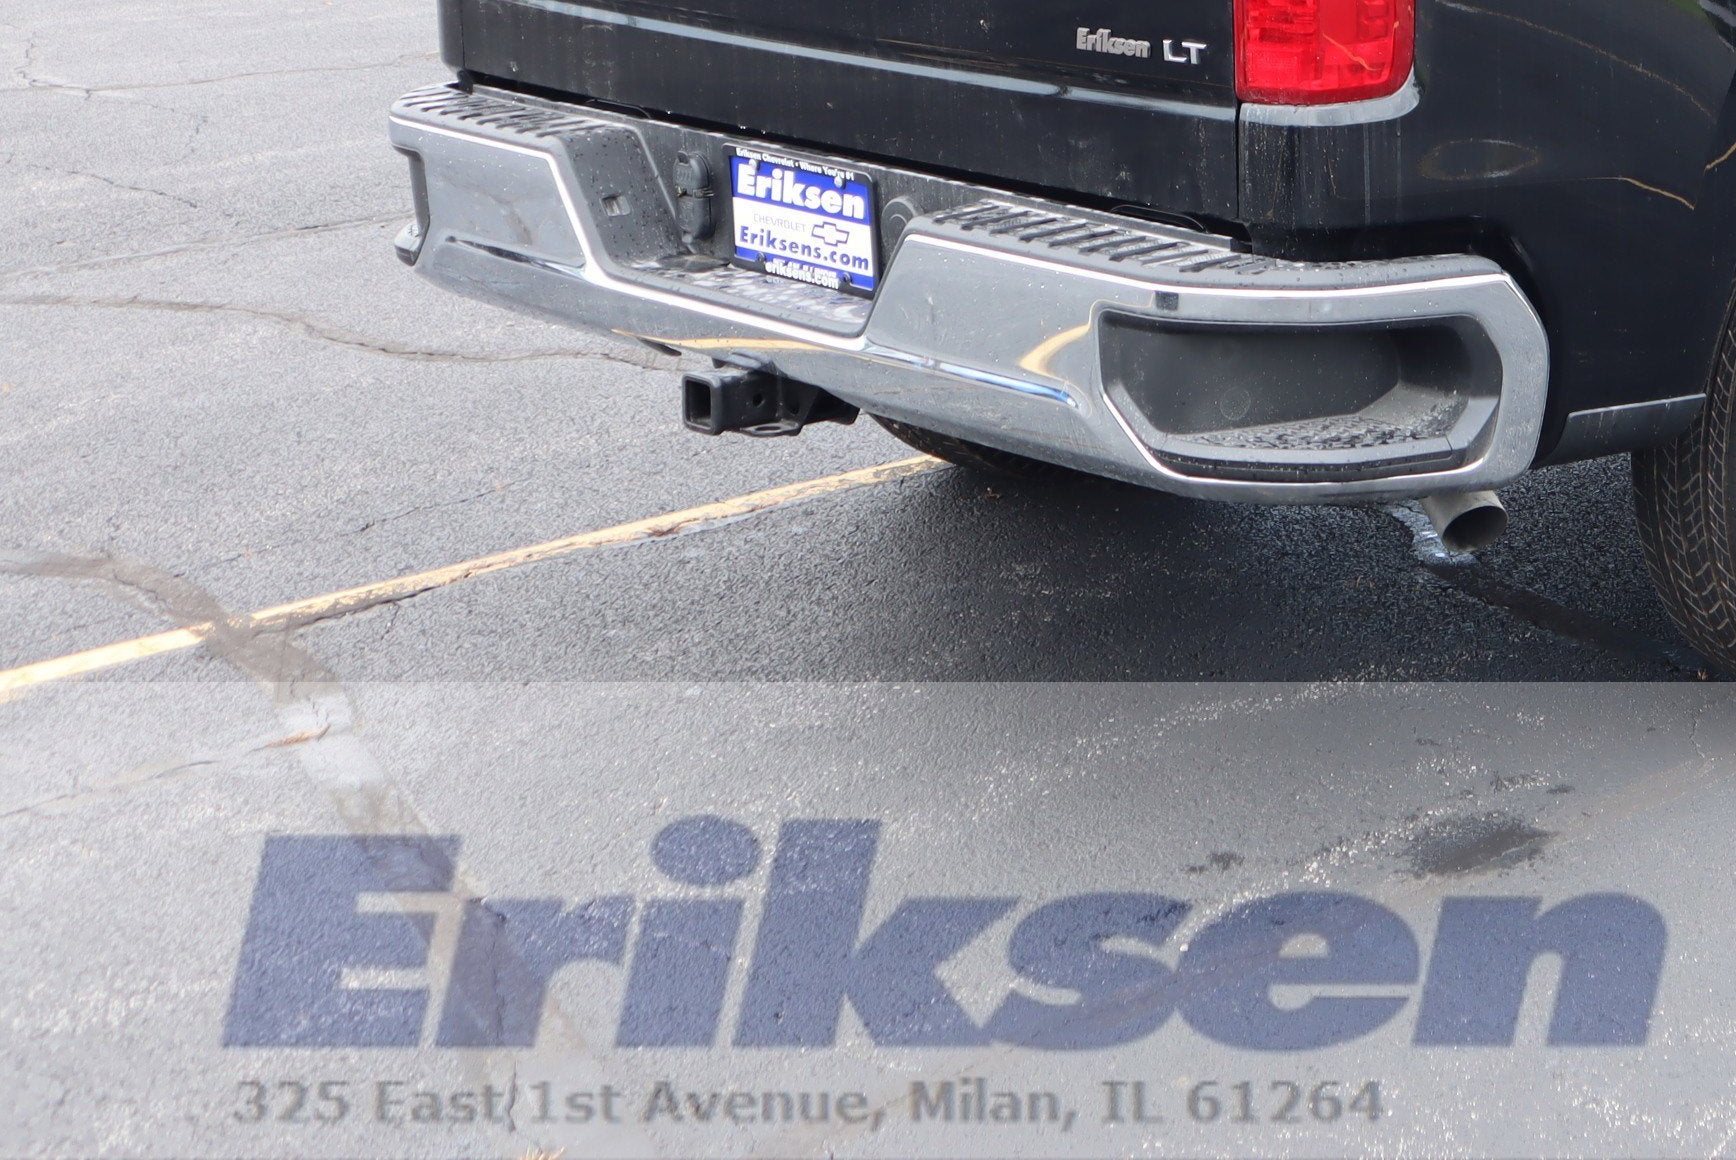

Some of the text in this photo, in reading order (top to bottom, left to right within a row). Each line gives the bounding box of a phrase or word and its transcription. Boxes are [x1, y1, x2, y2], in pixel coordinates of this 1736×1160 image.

[1076, 27, 1207, 65] Eriksen LT
[737, 163, 865, 220] Eriksen
[753, 213, 807, 233] CHEVROLET
[740, 225, 869, 271] Eriksens.com
